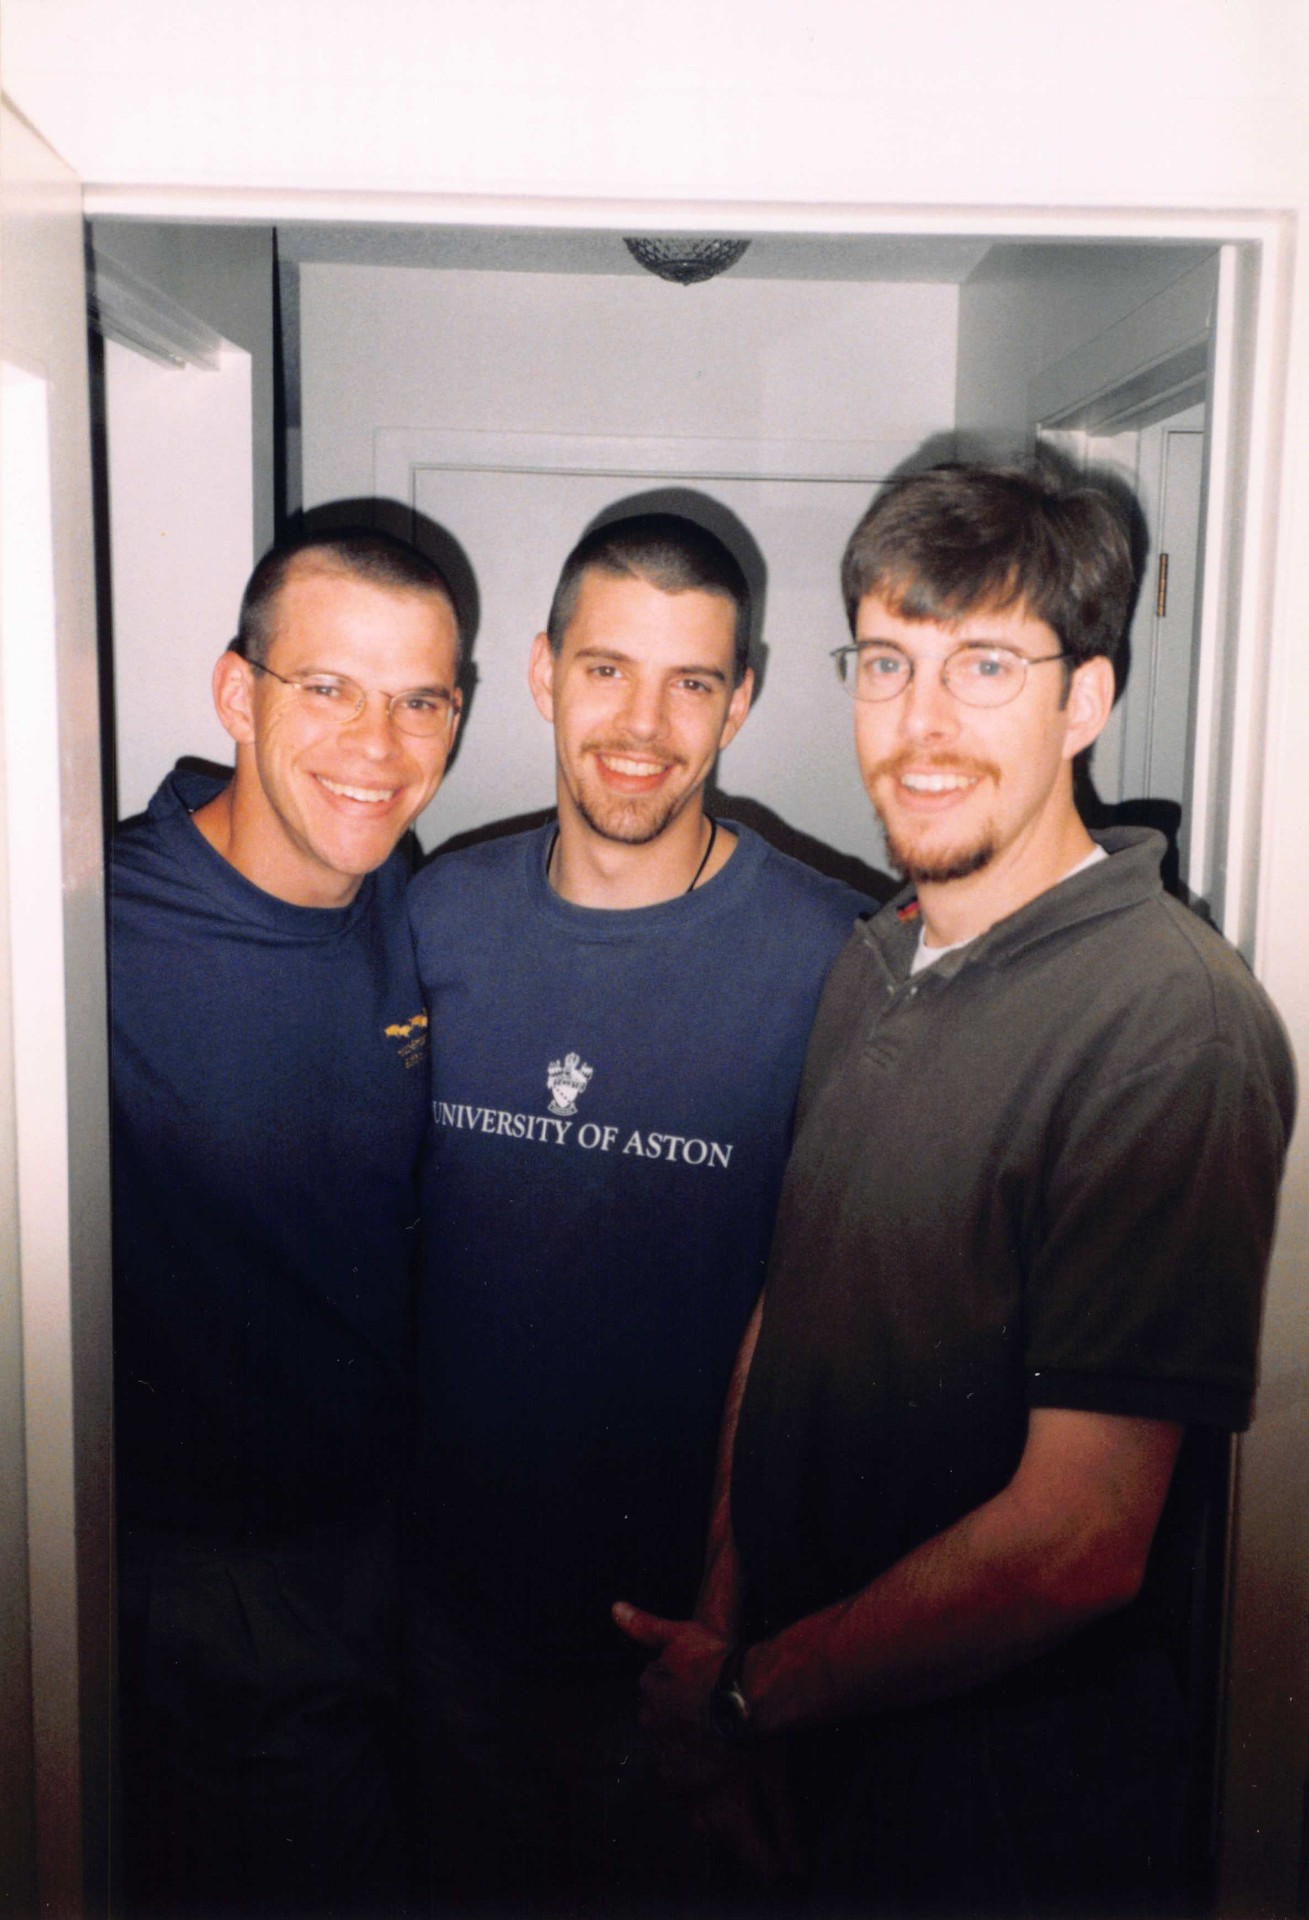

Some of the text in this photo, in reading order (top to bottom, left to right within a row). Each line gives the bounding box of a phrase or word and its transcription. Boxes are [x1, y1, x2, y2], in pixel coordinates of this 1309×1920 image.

[432, 1100, 733, 1168] UNIVERSITY OF ASTON
